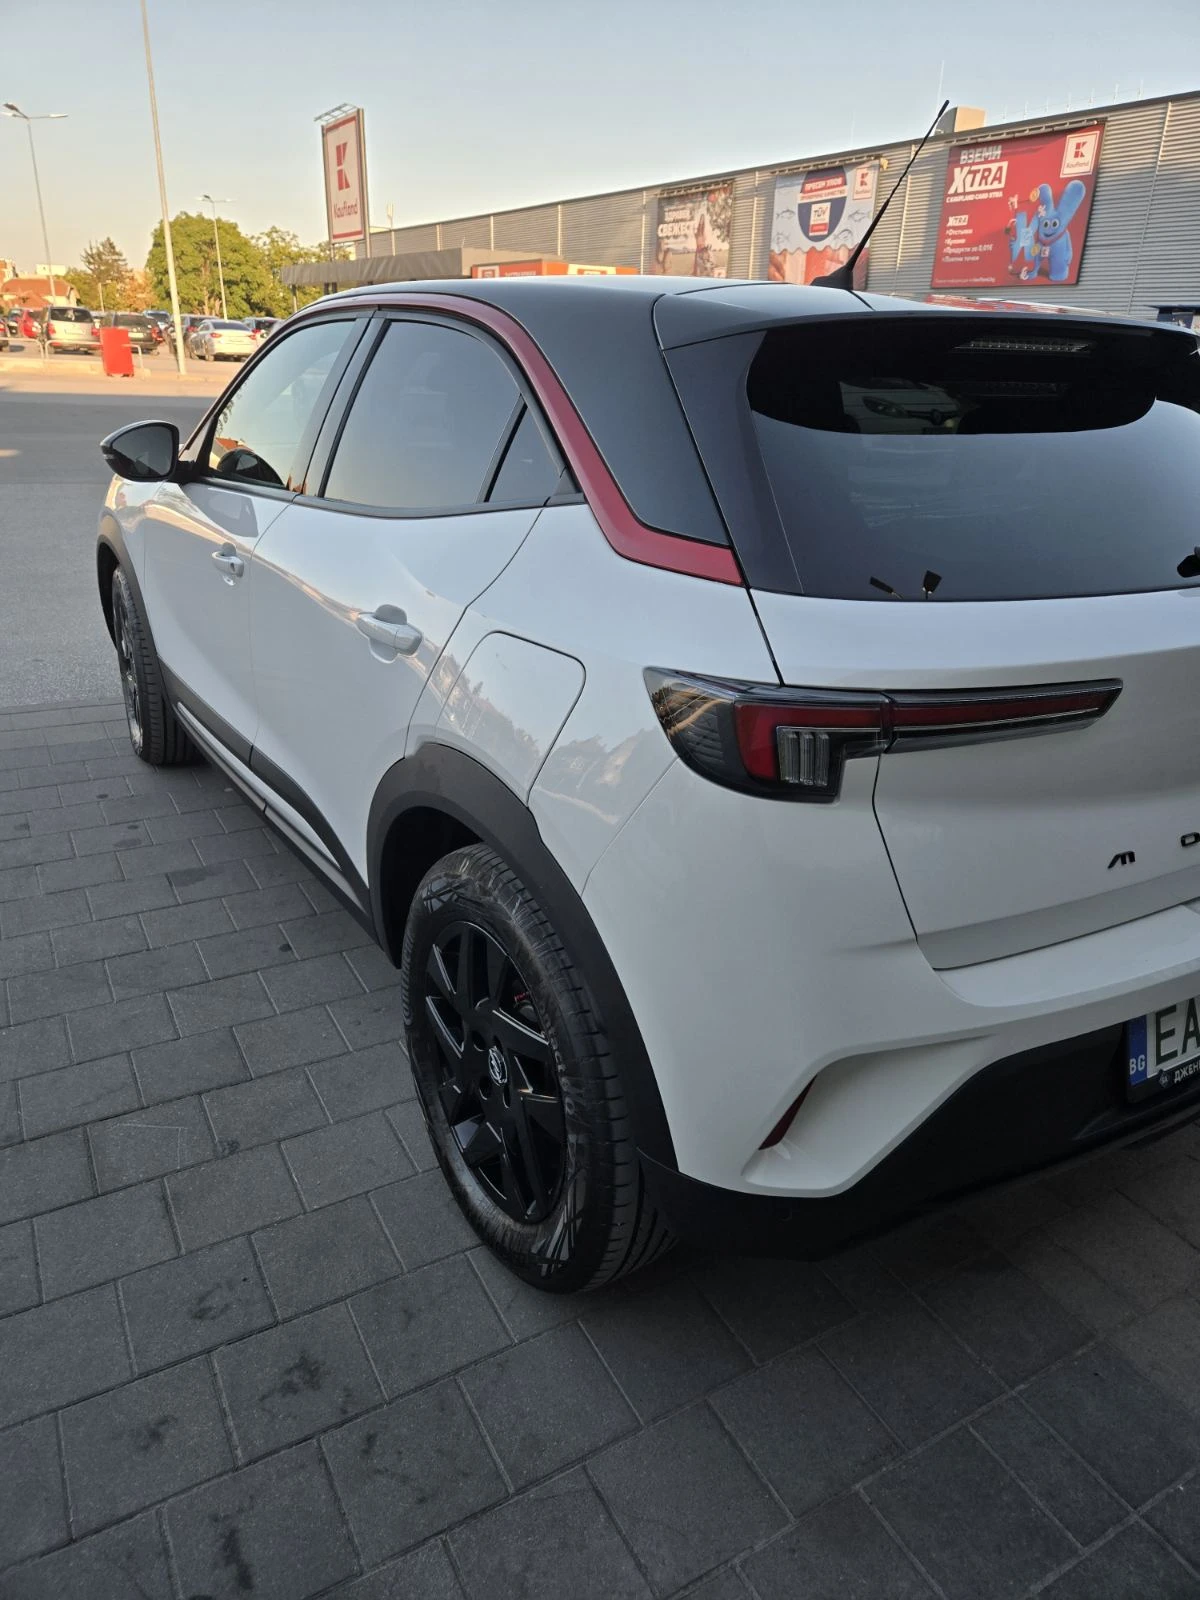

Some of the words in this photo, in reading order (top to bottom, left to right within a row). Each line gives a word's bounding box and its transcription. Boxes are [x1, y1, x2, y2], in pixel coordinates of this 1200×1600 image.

[959, 145, 1002, 164] ВЗЕМИ
[947, 163, 1004, 195] XTRA
[333, 200, 358, 219] Kaufland
[1155, 998, 1200, 1066] EA
[1129, 1054, 1146, 1075] BG
